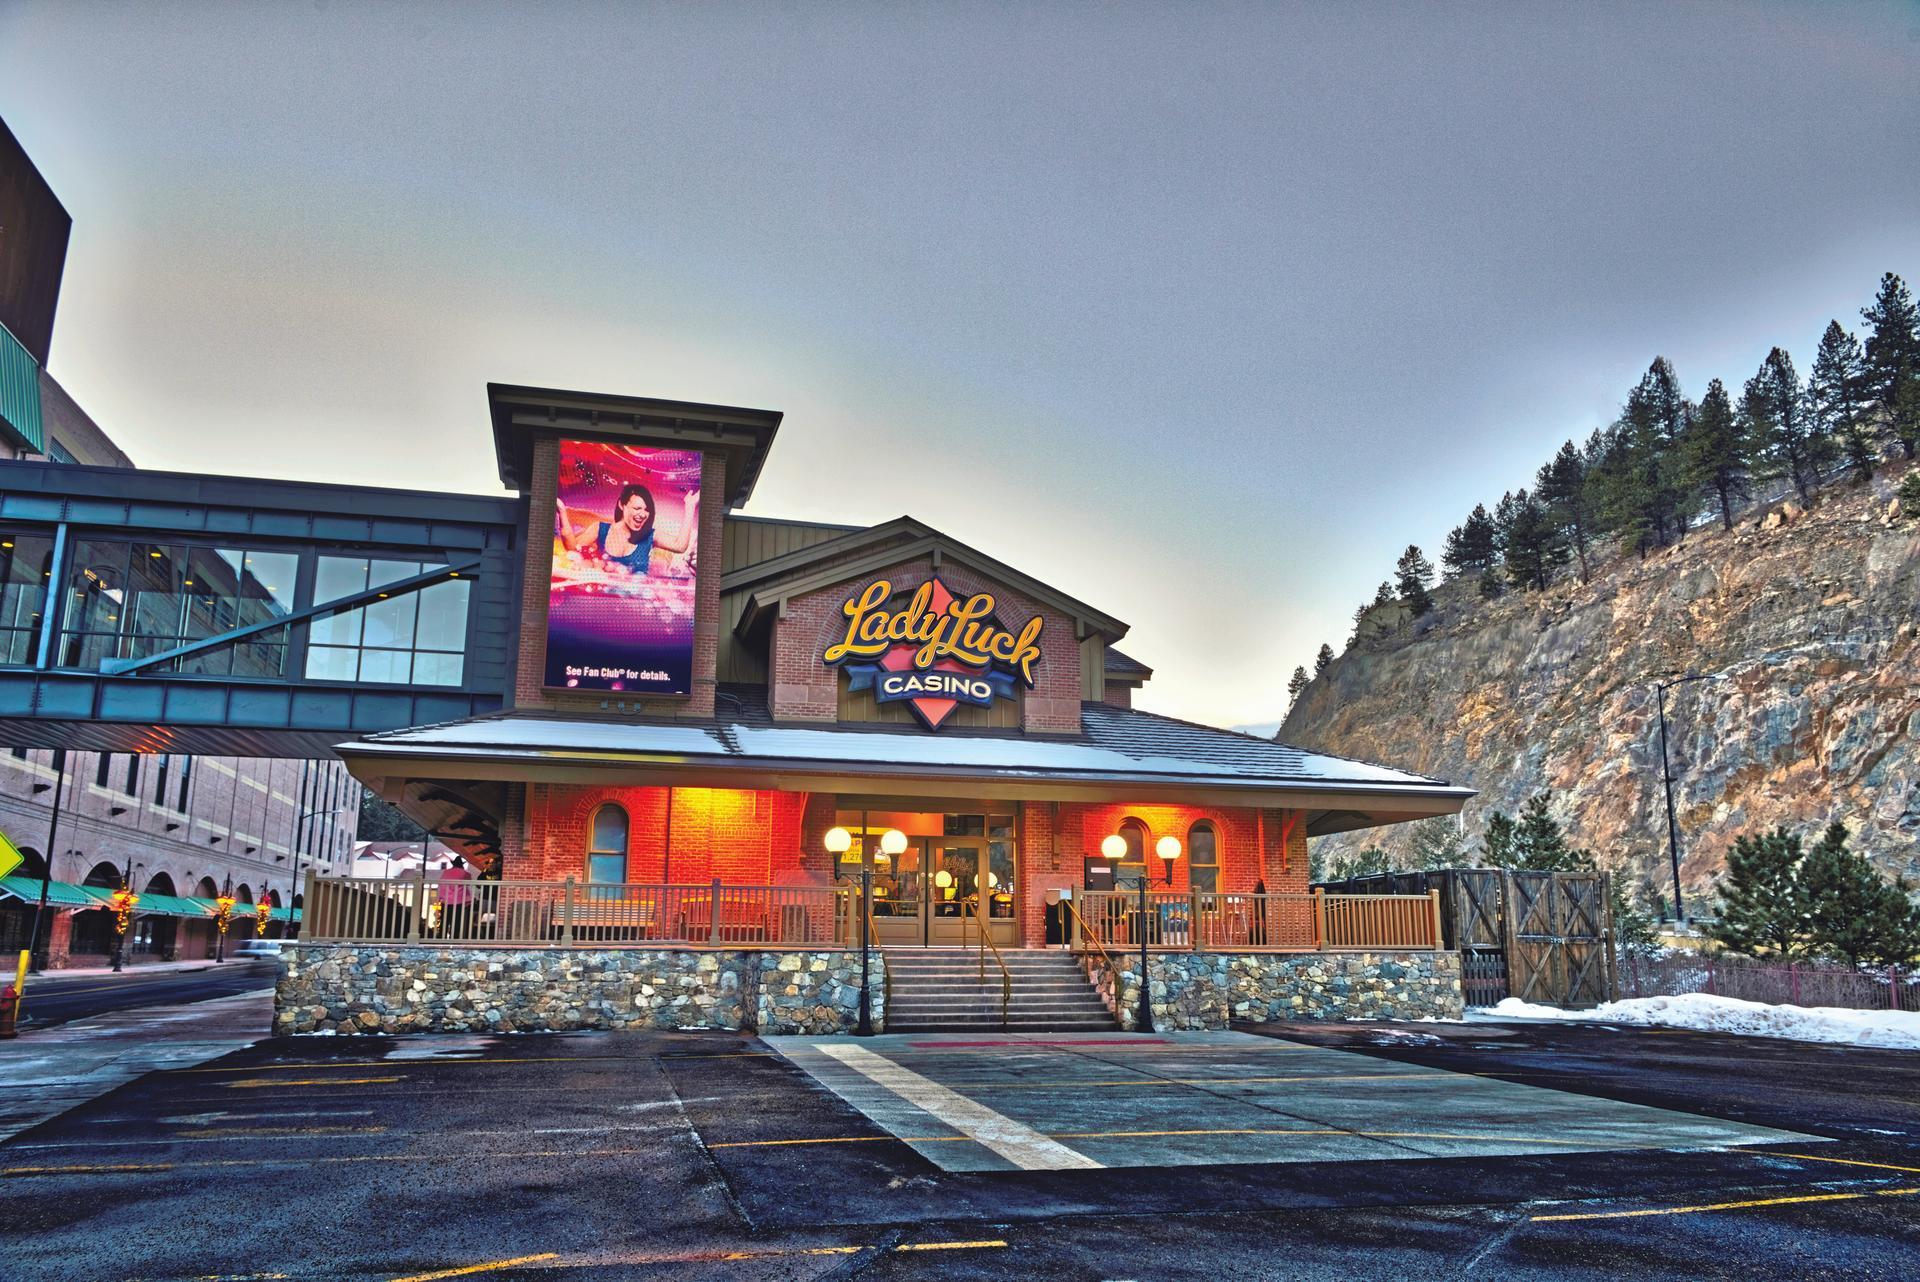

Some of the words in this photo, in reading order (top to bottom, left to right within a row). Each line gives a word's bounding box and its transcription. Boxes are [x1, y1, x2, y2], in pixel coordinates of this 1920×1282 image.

[823, 579, 949, 668] Lady
[936, 593, 1044, 685] Luck
[566, 665, 581, 676] See
[583, 666, 599, 677] Fan
[626, 669, 639, 680] for
[640, 670, 671, 681] details.
[883, 674, 992, 699] CASINO
